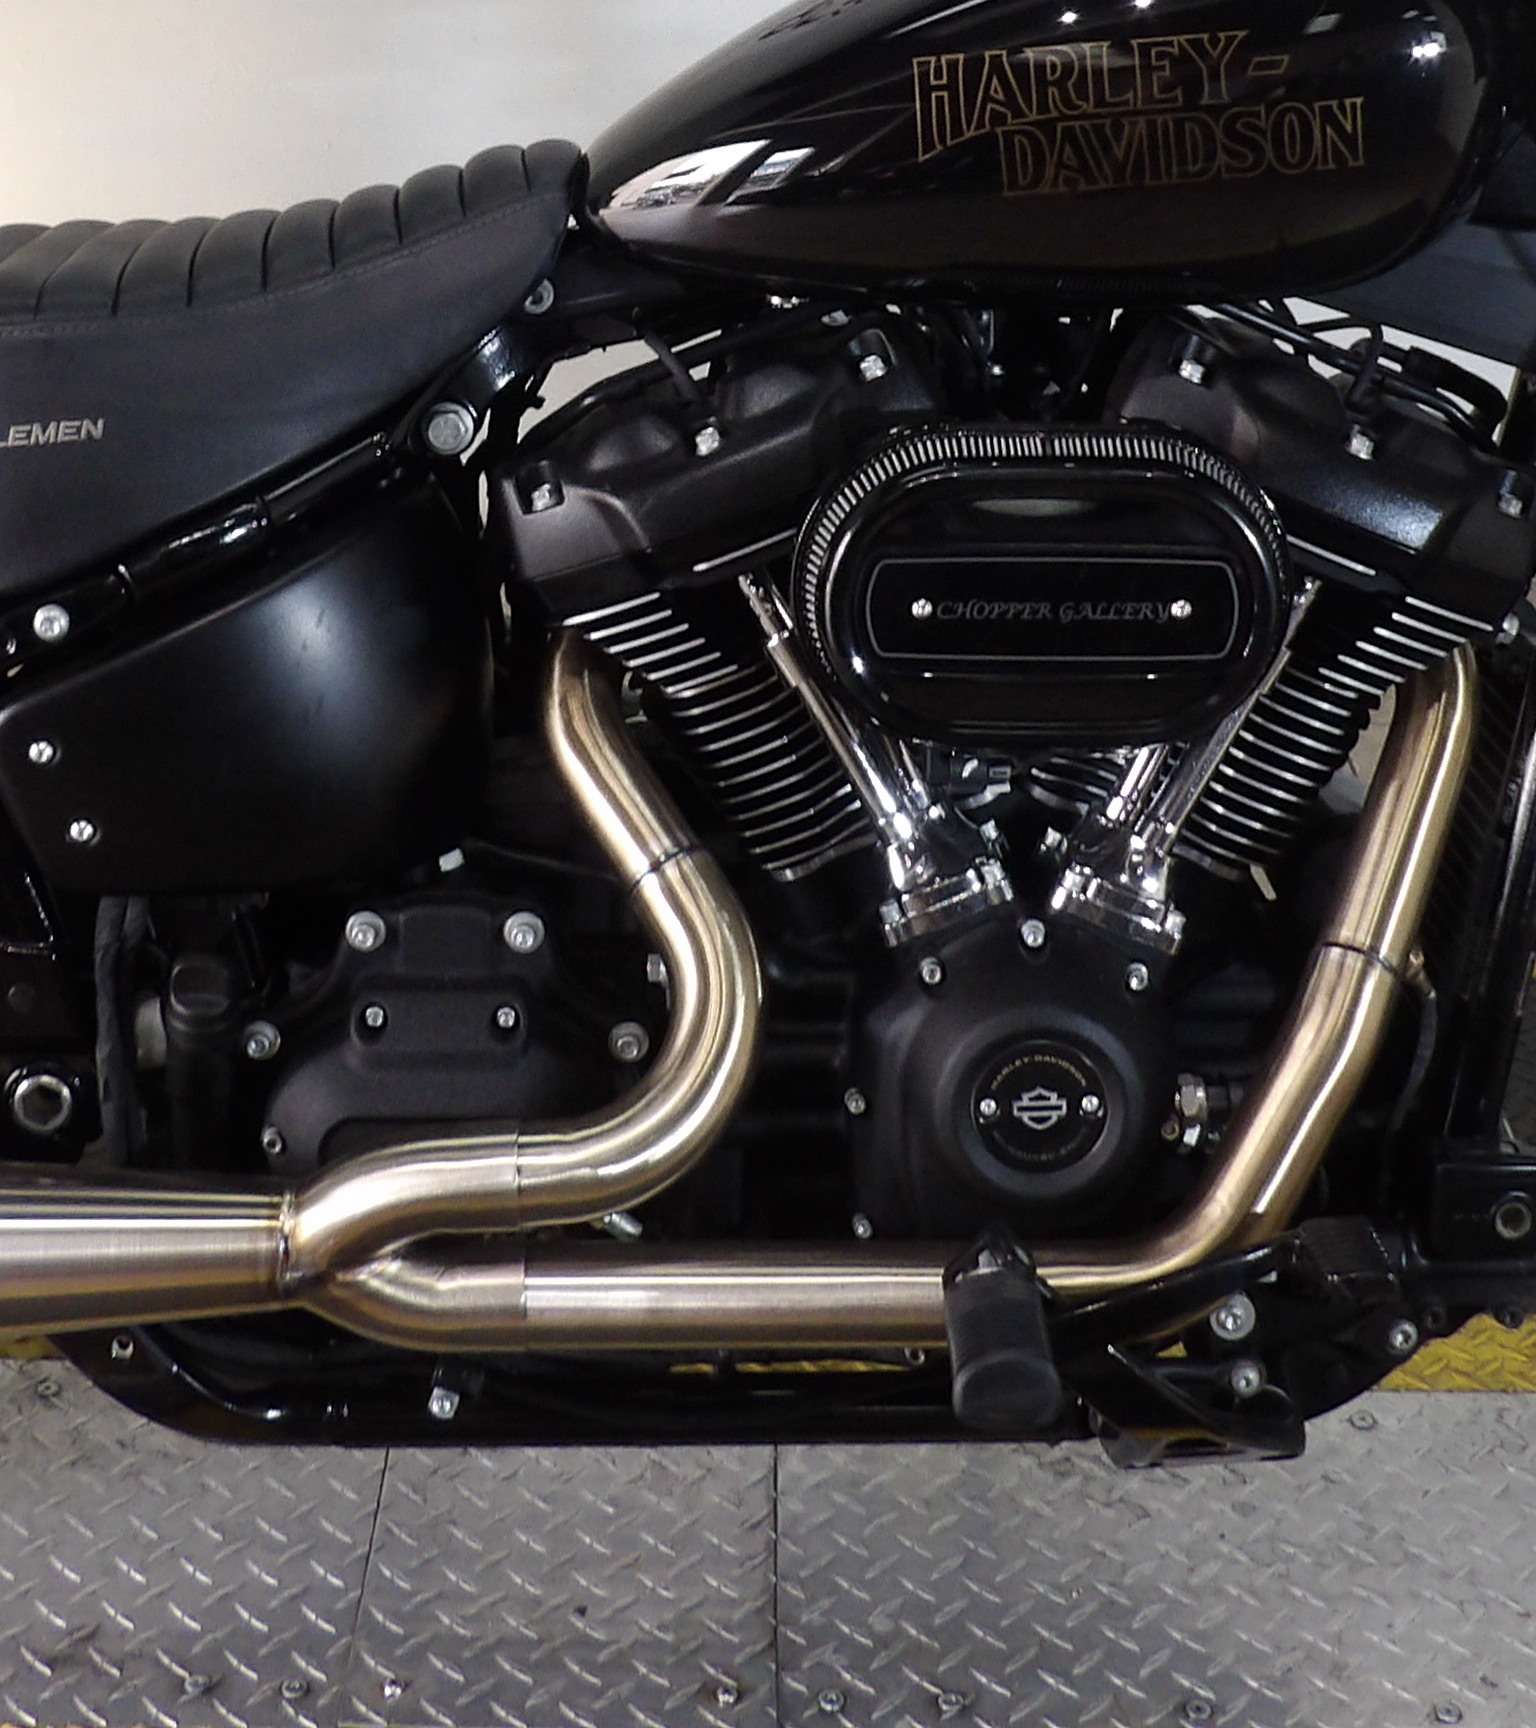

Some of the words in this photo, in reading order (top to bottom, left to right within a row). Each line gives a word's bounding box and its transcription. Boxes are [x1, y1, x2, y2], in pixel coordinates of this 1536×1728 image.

[912, 29, 1290, 162] HARLEY-
[996, 95, 1366, 197] DAVIDSON
[936, 598, 1054, 621] CHOPPER
[1058, 600, 1174, 624] GALLERY
